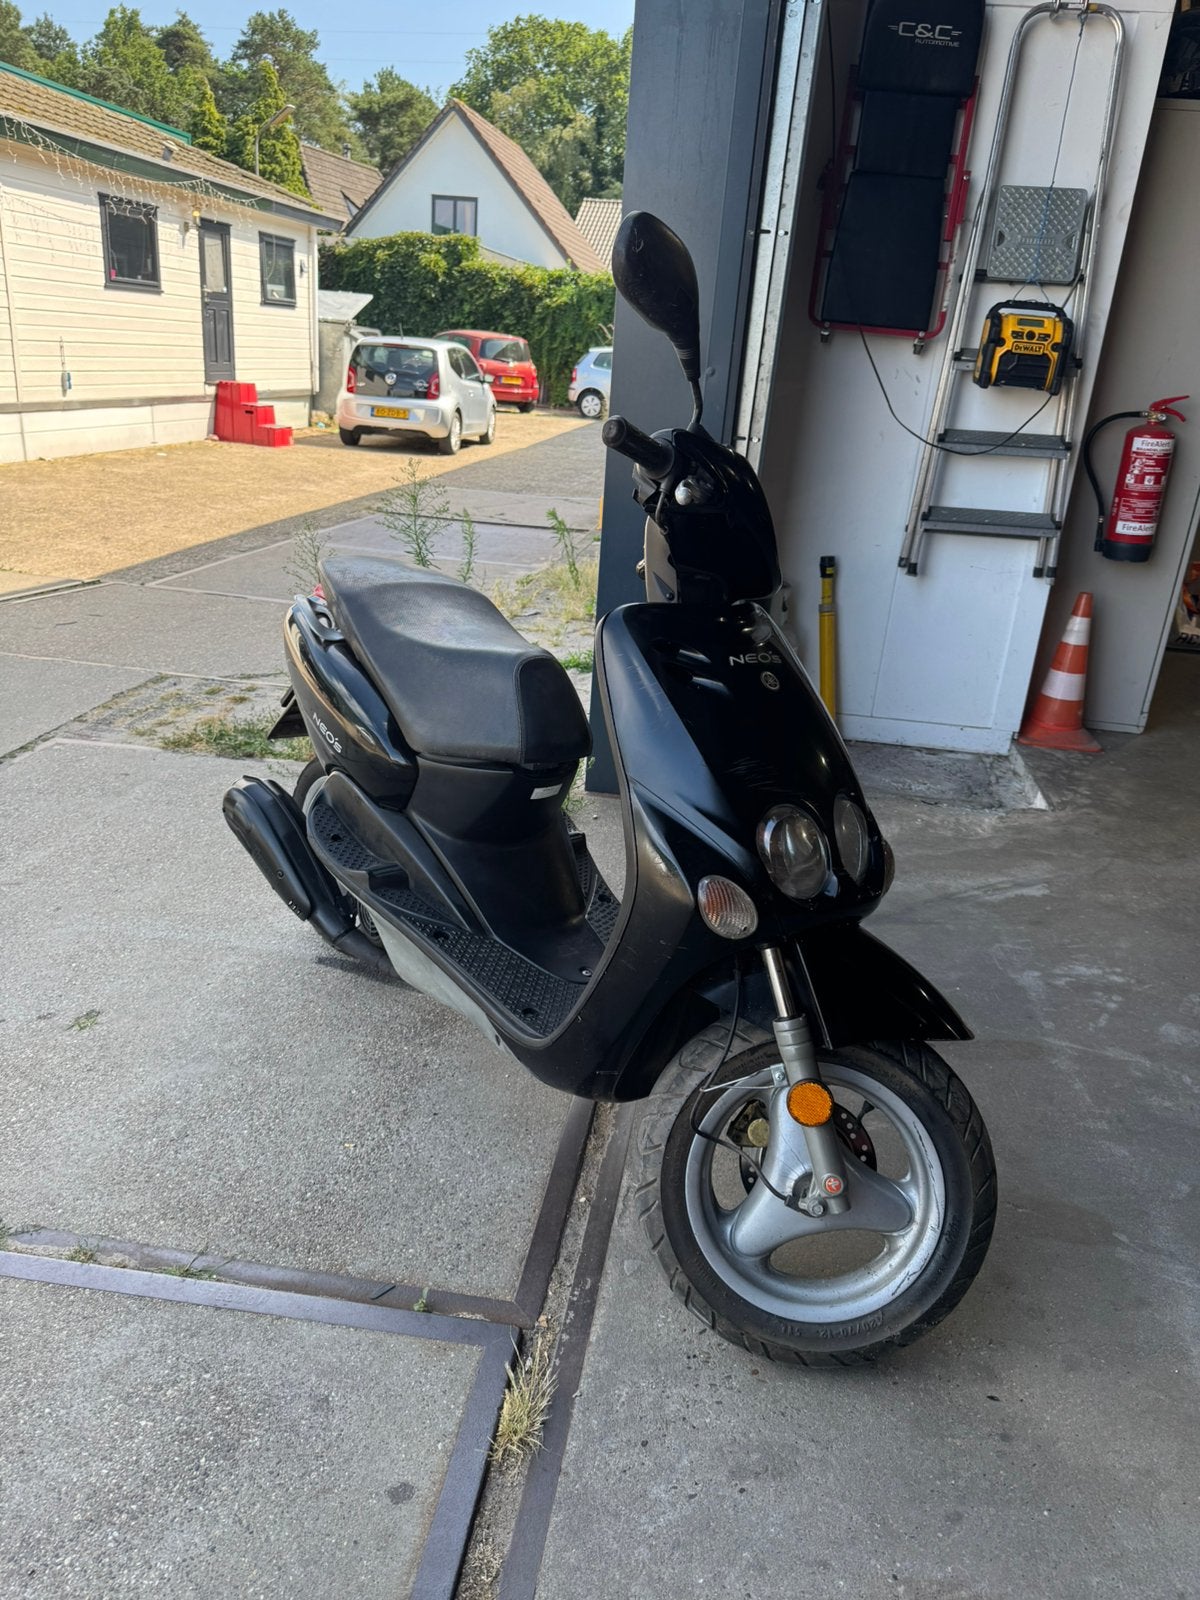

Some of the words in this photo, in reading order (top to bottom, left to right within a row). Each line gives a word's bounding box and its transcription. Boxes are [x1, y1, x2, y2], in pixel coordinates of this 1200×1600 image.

[898, 21, 953, 40] C&C
[914, 38, 961, 48] AUTOMOTIVE
[1014, 343, 1042, 353] DeWALT
[1140, 440, 1171, 449] FireAlert
